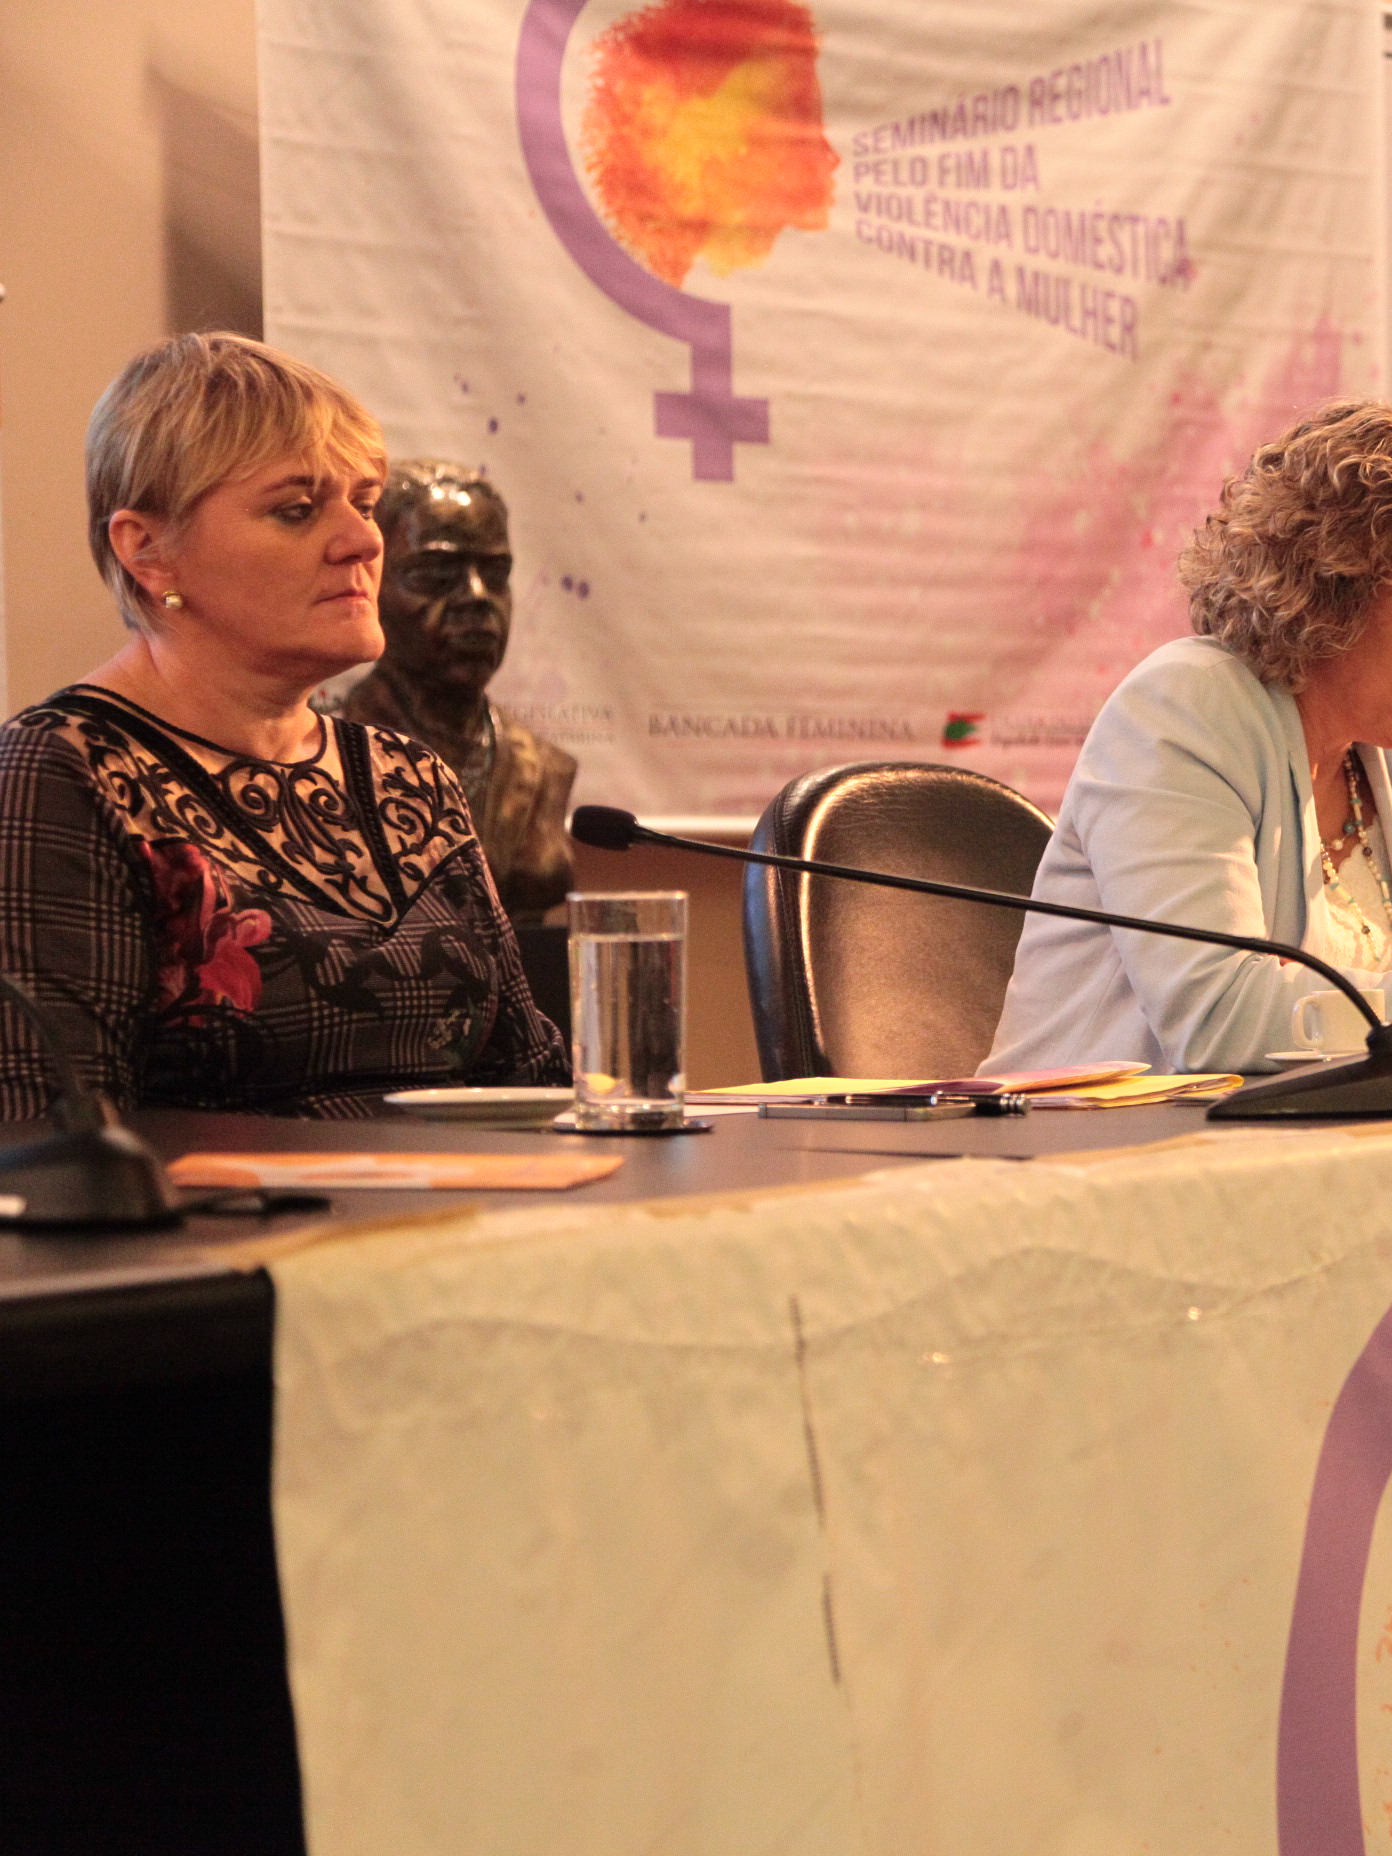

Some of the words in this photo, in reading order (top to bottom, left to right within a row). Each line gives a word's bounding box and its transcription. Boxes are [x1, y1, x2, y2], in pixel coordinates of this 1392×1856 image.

[852, 84, 1022, 158] SEMINÁRIO
[1028, 36, 1171, 128] REGIONAL
[852, 154, 928, 188] PELO
[937, 148, 992, 190] FIM
[1001, 143, 1041, 192] DA
[853, 190, 1014, 250] VIOLÊNCIA
[1022, 200, 1190, 291] DOMÉSTICA
[855, 217, 978, 290] CONTRA
[987, 257, 1007, 307] A
[1015, 265, 1140, 363] MULHER
[648, 711, 777, 741] BANCADA
[785, 713, 915, 743] FEMININA
